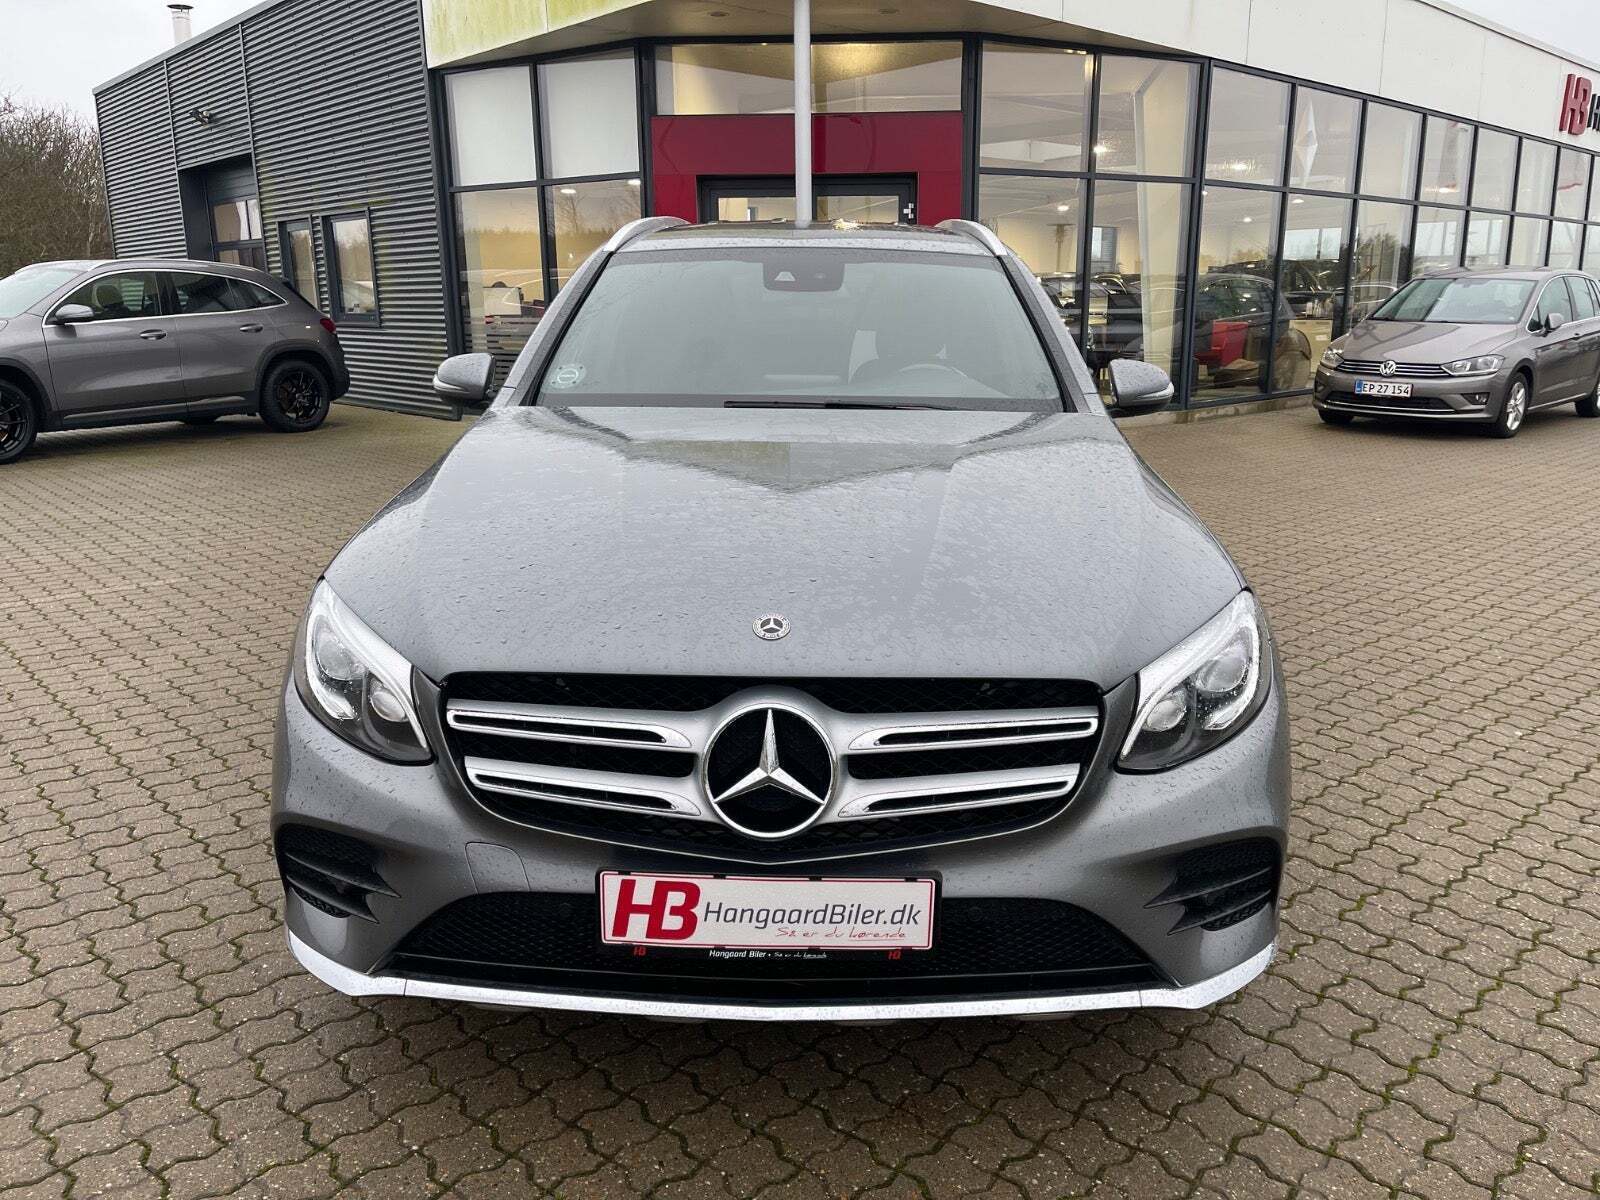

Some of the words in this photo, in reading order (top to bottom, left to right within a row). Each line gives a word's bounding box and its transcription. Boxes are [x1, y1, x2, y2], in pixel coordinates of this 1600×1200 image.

[1559, 74, 1592, 135] HB
[1587, 93, 1600, 132] H
[1363, 383, 1375, 392] EP
[1377, 384, 1389, 394] 27
[1392, 385, 1409, 395] 154
[612, 879, 700, 940] HB
[704, 902, 922, 929] HangaardBiler.dk
[710, 950, 747, 959] Hangaard
